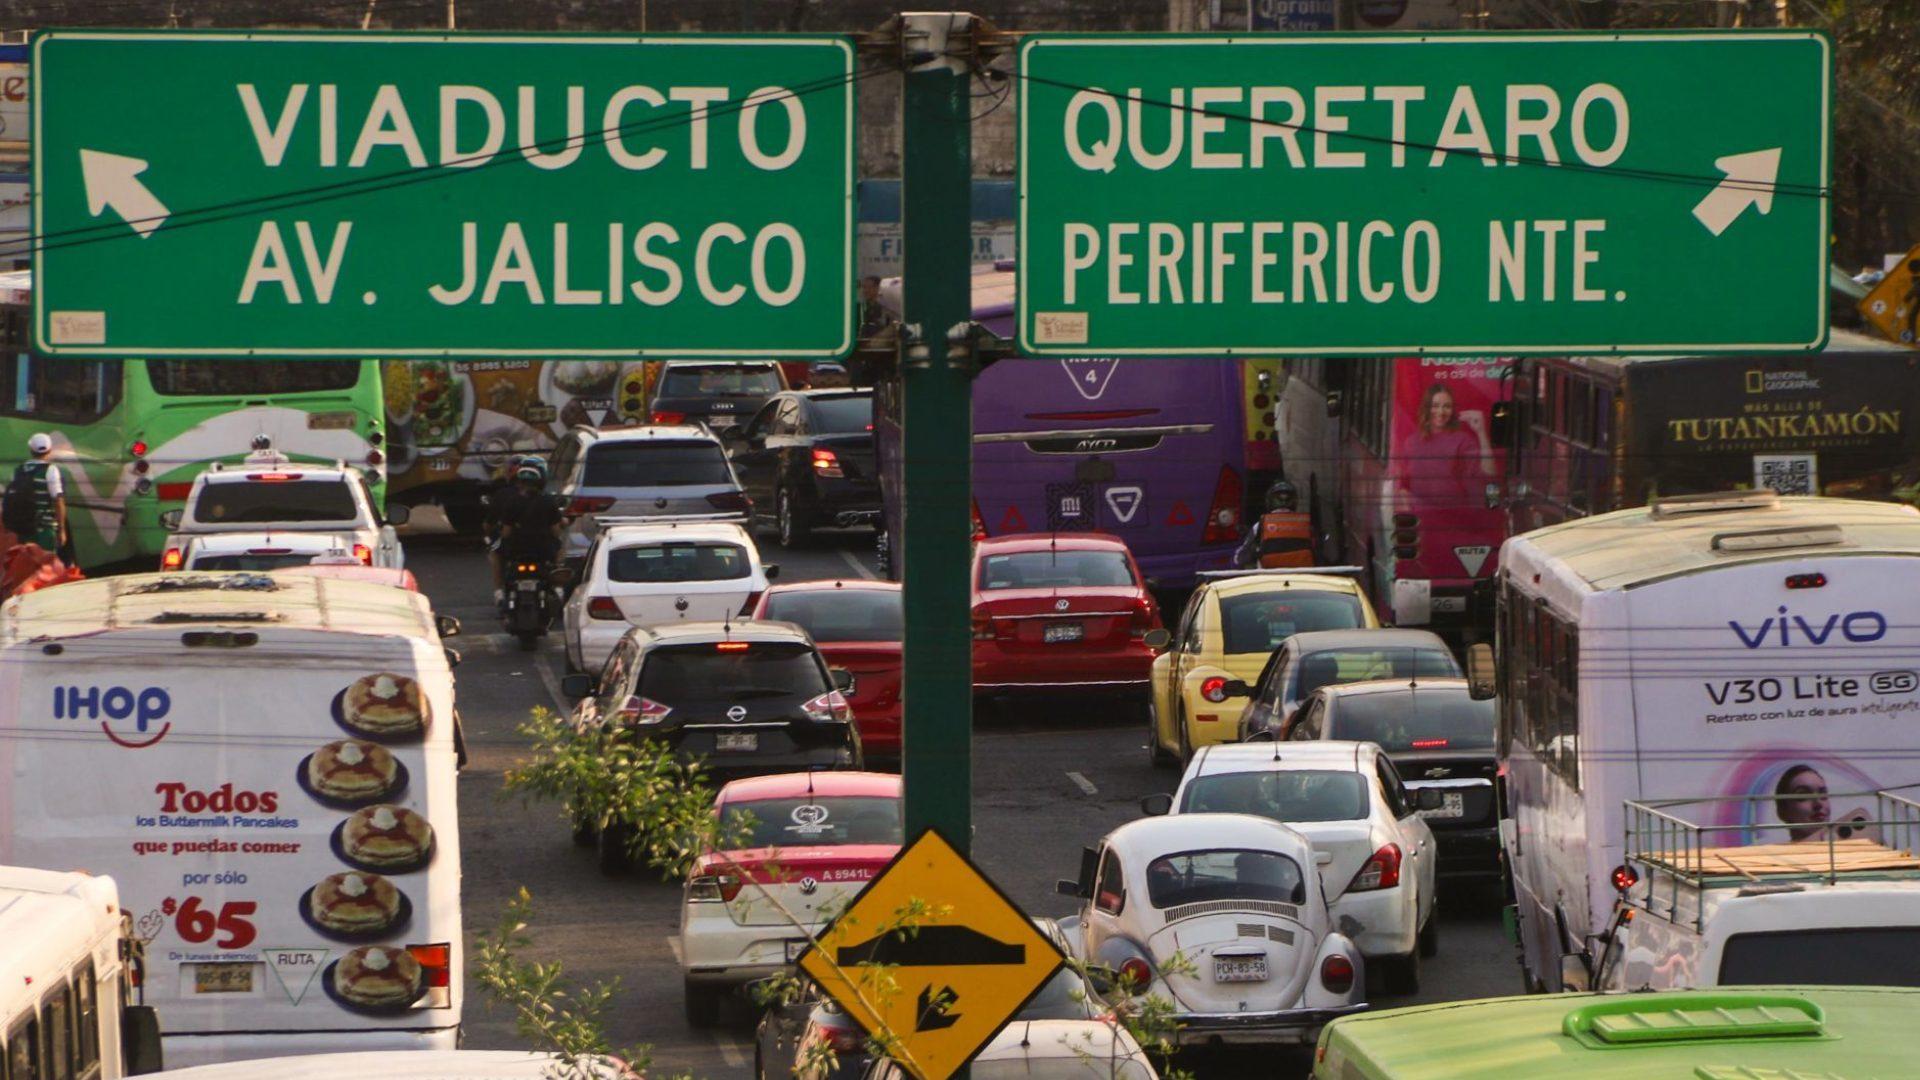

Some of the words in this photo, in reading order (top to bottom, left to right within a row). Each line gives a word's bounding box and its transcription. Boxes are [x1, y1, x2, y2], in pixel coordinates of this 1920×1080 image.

[237, 84, 806, 170] VIADUCTO
[1064, 83, 1630, 175] QUERETARO
[238, 221, 376, 305] AV.
[429, 222, 806, 306] JALISCO
[1064, 220, 1441, 304] PERIFERICO
[1489, 219, 1627, 302] NTE.
[1085, 369, 1098, 383] 4
[1668, 405, 1900, 442] TUTANKAMÓN
[1728, 605, 1887, 649] vivo
[1705, 678, 1782, 706] V30
[1794, 674, 1859, 700] Lite
[1876, 675, 1911, 690] 5G
[1706, 712, 1758, 724] Retrato
[1760, 710, 1785, 722] con
[1787, 708, 1805, 719] luz
[1808, 706, 1824, 717] de
[1828, 707, 1858, 717] aura
[155, 782, 279, 814] Todos
[136, 815, 156, 828] los
[159, 815, 229, 828] Buttermilk
[233, 816, 299, 828] Pancakes
[133, 841, 168, 856] que
[171, 838, 238, 856] puedas
[241, 842, 301, 854] comer
[183, 873, 211, 887] por
[214, 870, 248, 885] sólo
[161, 896, 258, 949] $65
[169, 951, 182, 961] De
[277, 953, 316, 965] RUTA
